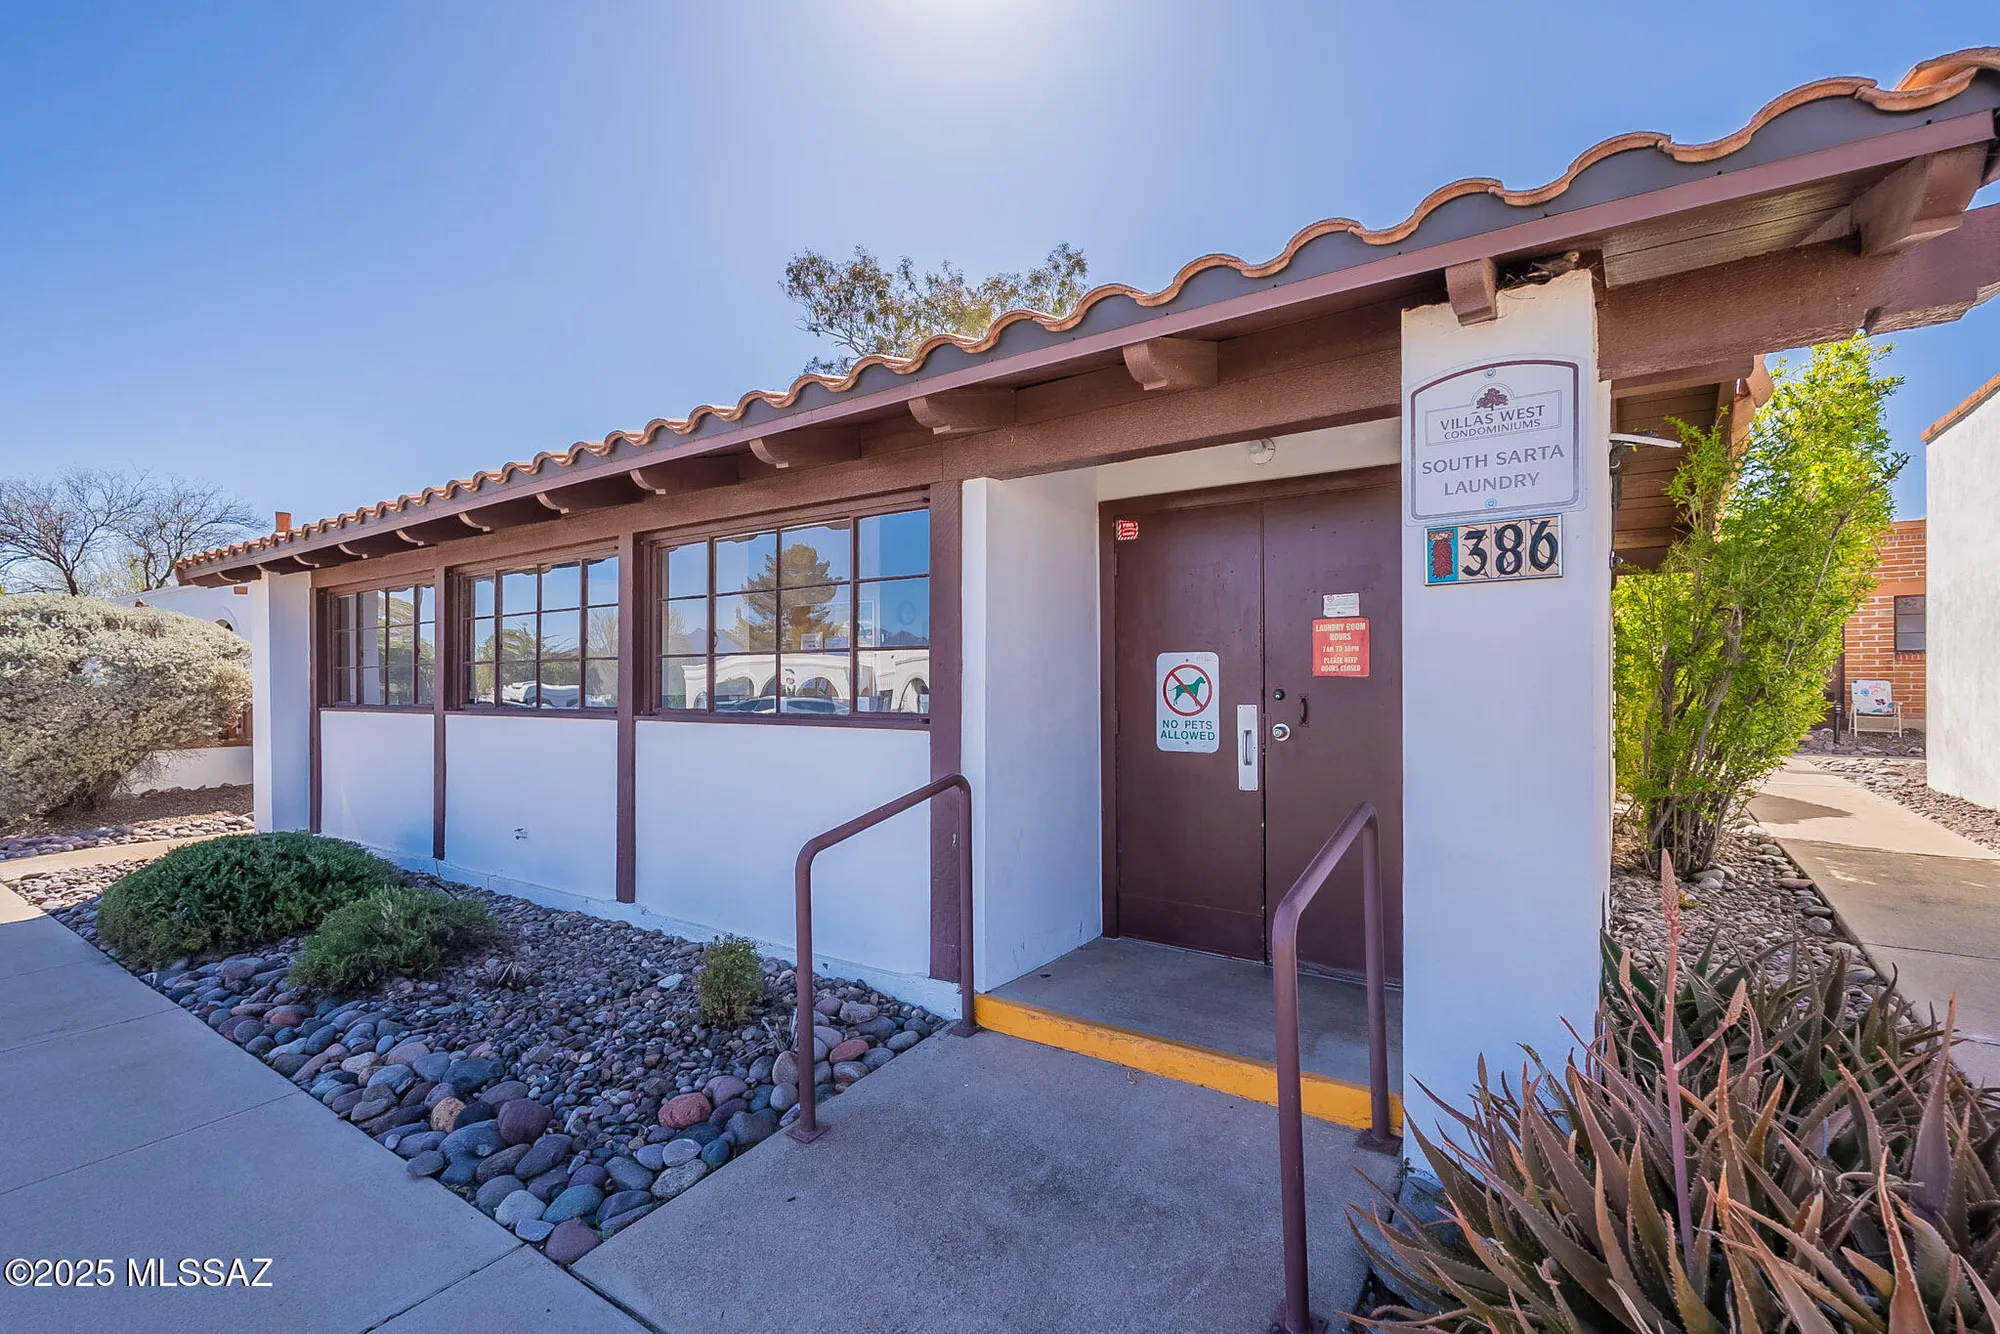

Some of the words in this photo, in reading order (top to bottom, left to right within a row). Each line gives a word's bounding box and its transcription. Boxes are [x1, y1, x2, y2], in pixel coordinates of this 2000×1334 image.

[1440, 412, 1494, 431] VILLAS
[1500, 404, 1546, 422] WEST
[1444, 418, 1541, 440] CONDOMINIUMS
[1421, 454, 1488, 475] SOUTH
[1496, 444, 1565, 466] SARTA
[1444, 472, 1540, 496] LAUNDRY
[1461, 520, 1559, 577] 386
[1315, 623, 1345, 632] LAUNDRY
[1346, 622, 1366, 631] ROOM
[1329, 632, 1352, 641] HOURS
[1323, 656, 1343, 664] PLEASE
[1162, 719, 1178, 729] NO
[1184, 720, 1213, 730] PETS
[1160, 730, 1216, 741] ALLOWED
